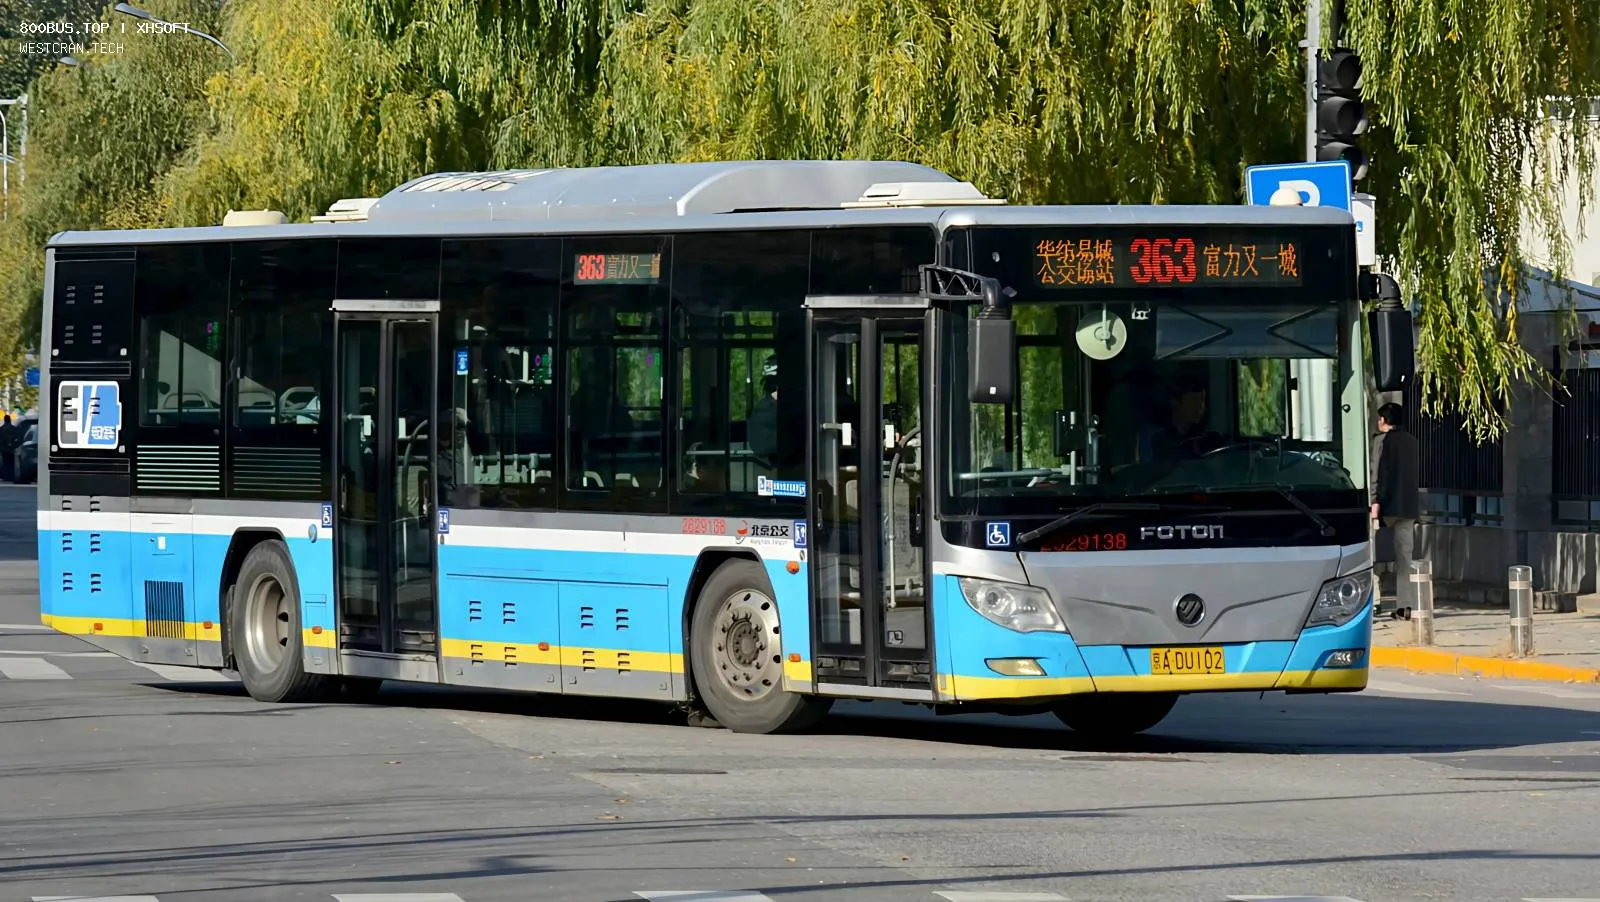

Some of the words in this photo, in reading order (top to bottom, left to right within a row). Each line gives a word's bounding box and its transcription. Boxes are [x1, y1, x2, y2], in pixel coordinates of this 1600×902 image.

[577, 254, 606, 280] 363
[1129, 238, 1196, 284] 363
[1203, 243, 1298, 278] 富力又一城
[751, 524, 789, 537] 北京公交
[1140, 524, 1224, 540] FOTON
